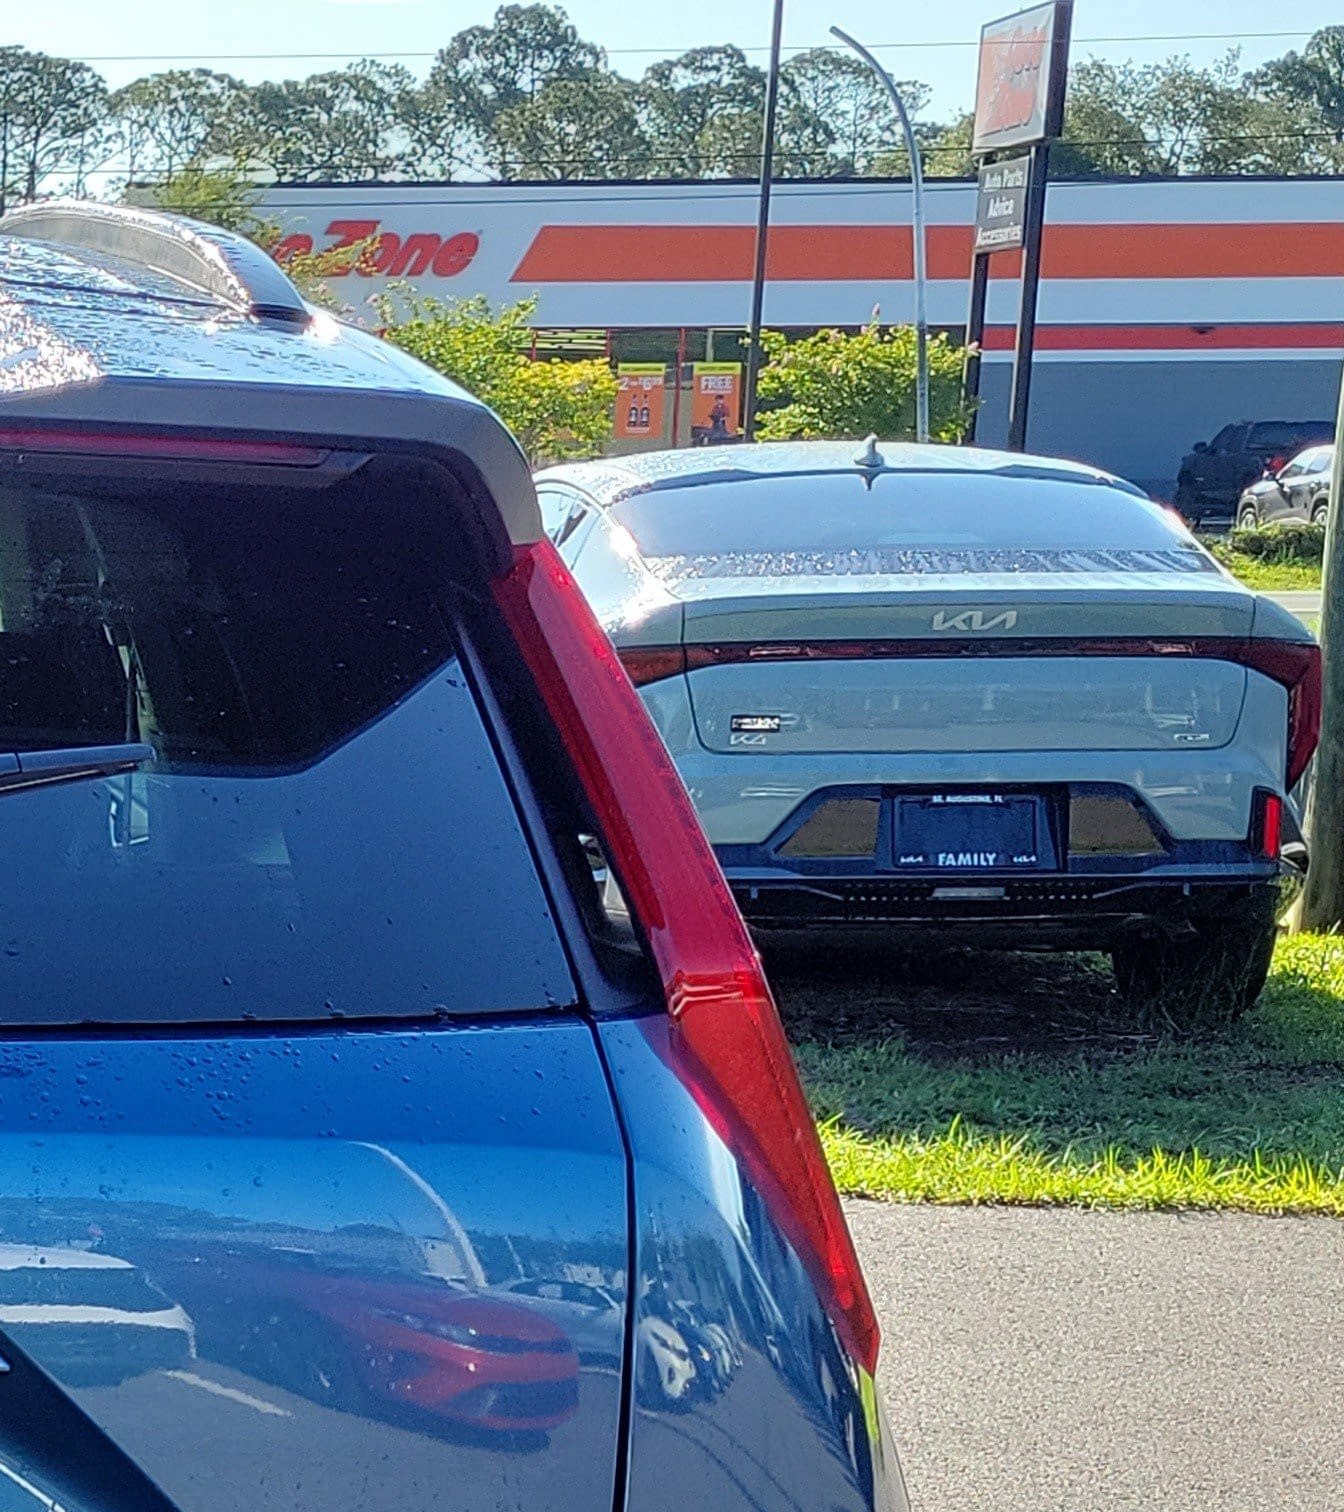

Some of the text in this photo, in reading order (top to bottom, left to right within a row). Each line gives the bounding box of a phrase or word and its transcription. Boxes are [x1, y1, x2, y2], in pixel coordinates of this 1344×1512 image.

[987, 196, 1015, 219] Advice
[932, 610, 1018, 631] KIA
[937, 852, 997, 867] FAMILY
